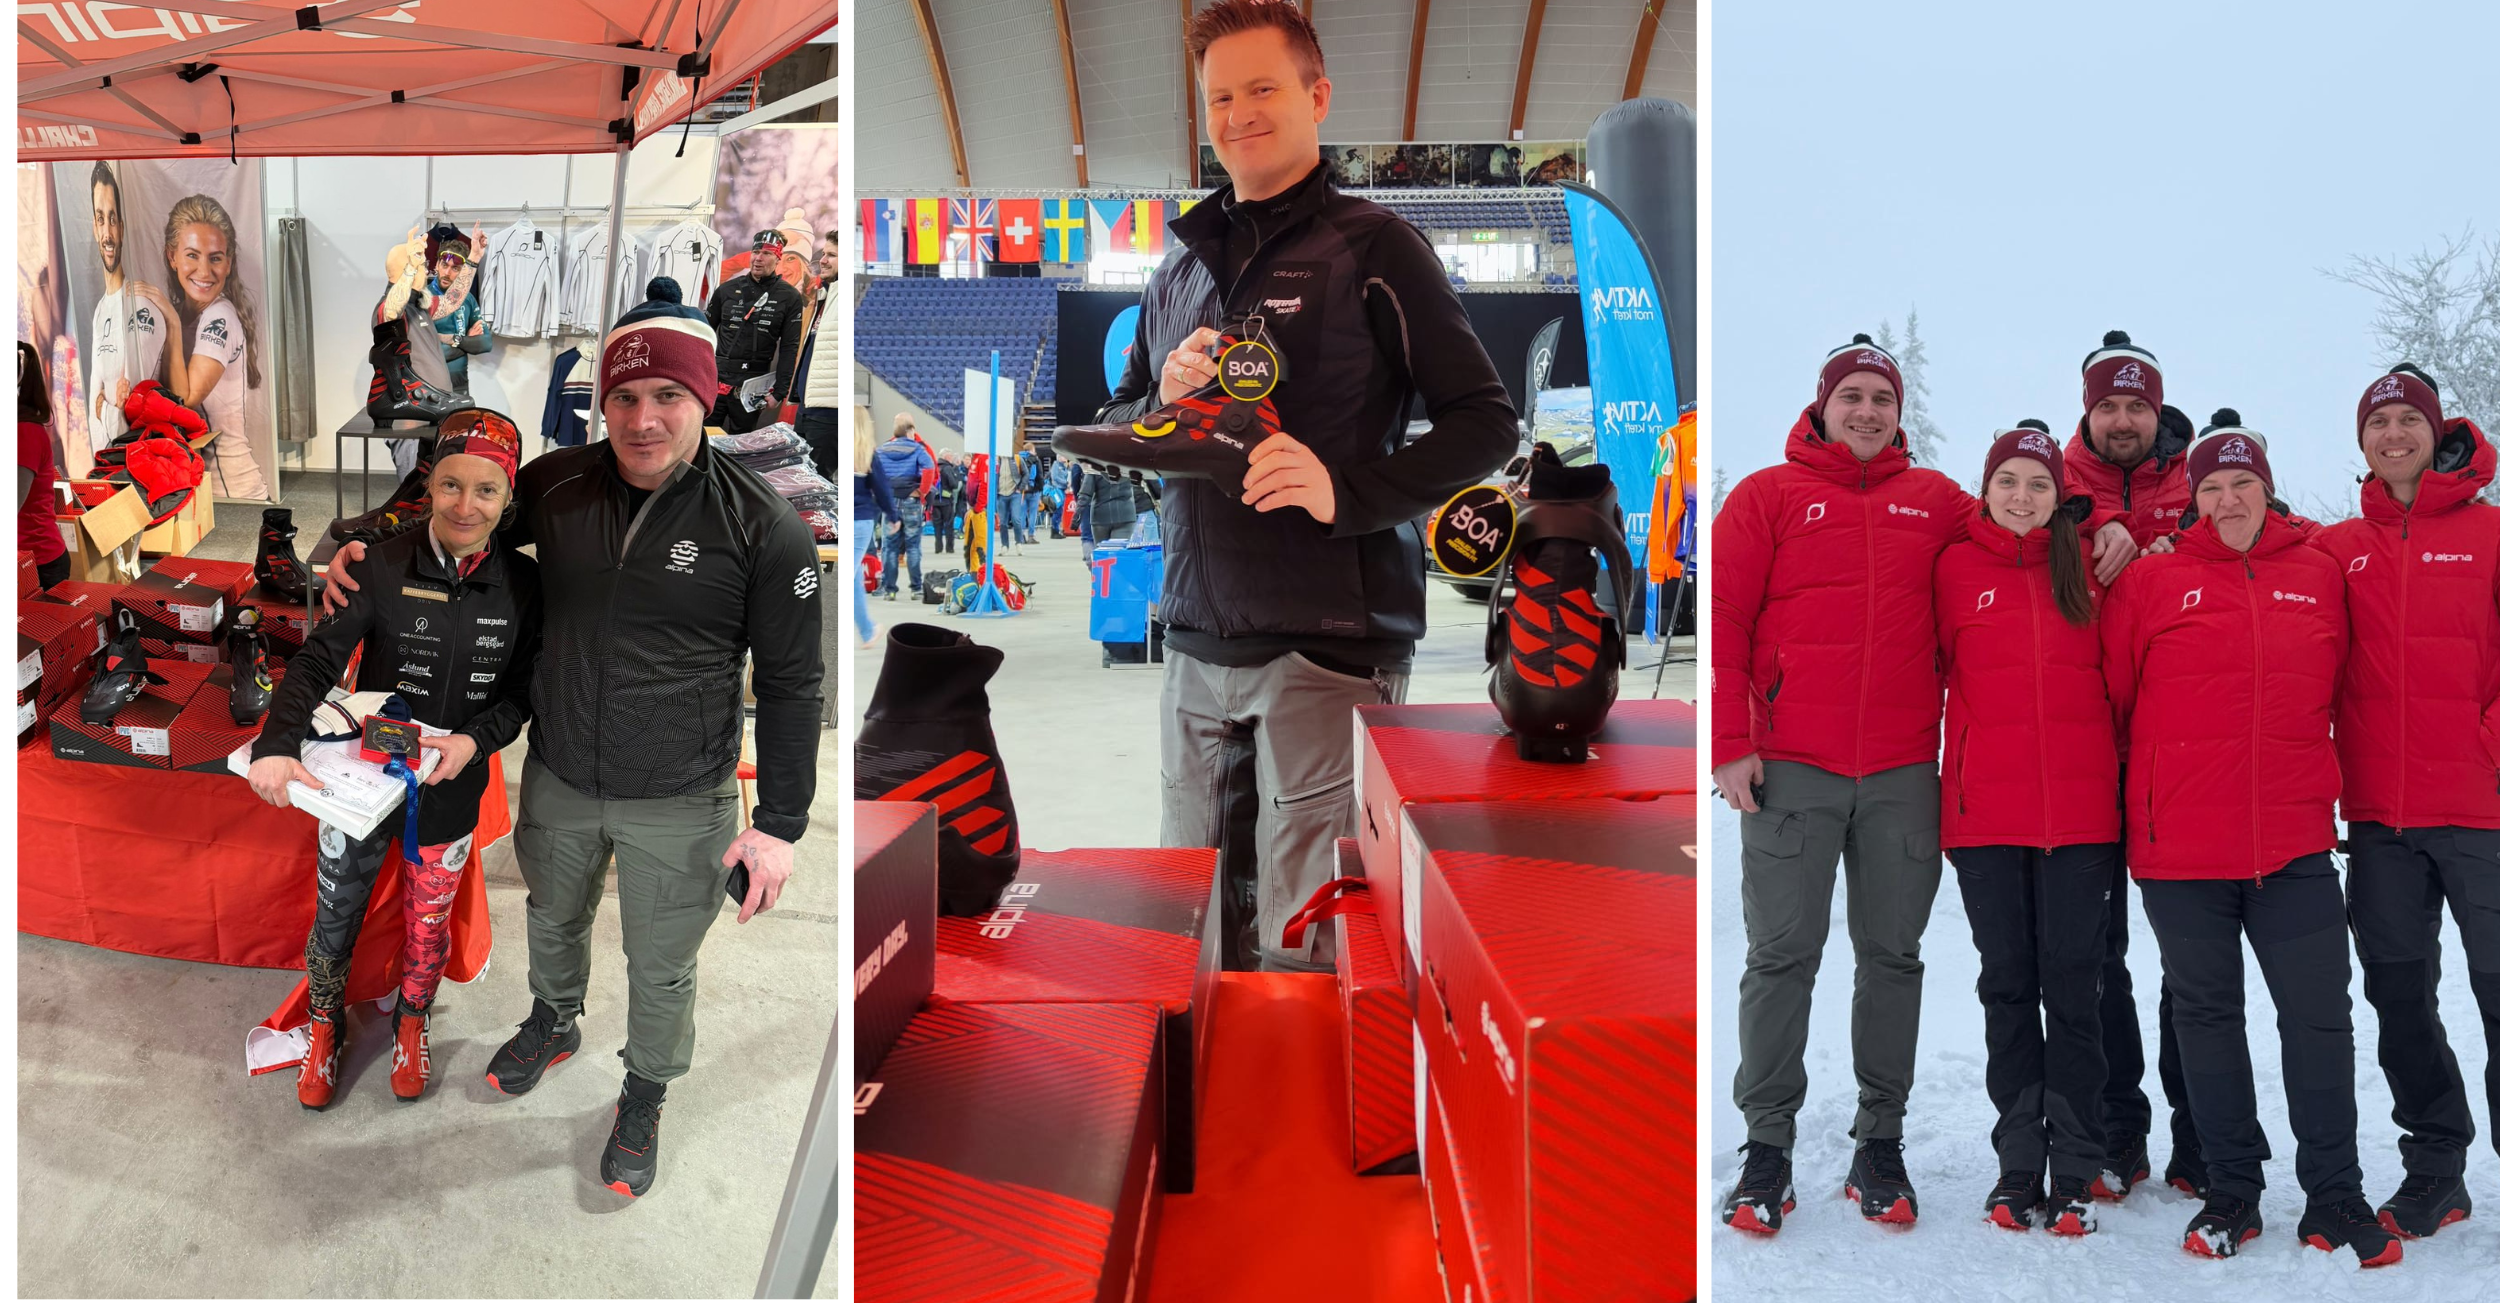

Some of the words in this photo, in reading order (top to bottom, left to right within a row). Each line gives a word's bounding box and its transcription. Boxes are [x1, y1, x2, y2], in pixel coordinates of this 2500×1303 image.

[200, 333, 227, 349] BIRKEN
[610, 356, 649, 379] BIRKEN
[1228, 360, 1269, 377] BOA
[1856, 358, 1890, 372] BIRKEN
[2113, 379, 2145, 391] BIRKEN
[2370, 389, 2404, 405] BIRKEN
[1213, 432, 1244, 450] alpina
[2017, 442, 2051, 460] BIRKEN
[2217, 454, 2253, 465] BIRKEN
[1898, 507, 1929, 518] alpina
[2165, 507, 2185, 517] alp
[1448, 504, 1500, 553] BOA
[2434, 552, 2473, 563] alpina
[665, 563, 694, 575] alpina
[2284, 591, 2317, 604] alpina
[477, 618, 508, 626] maxpulse
